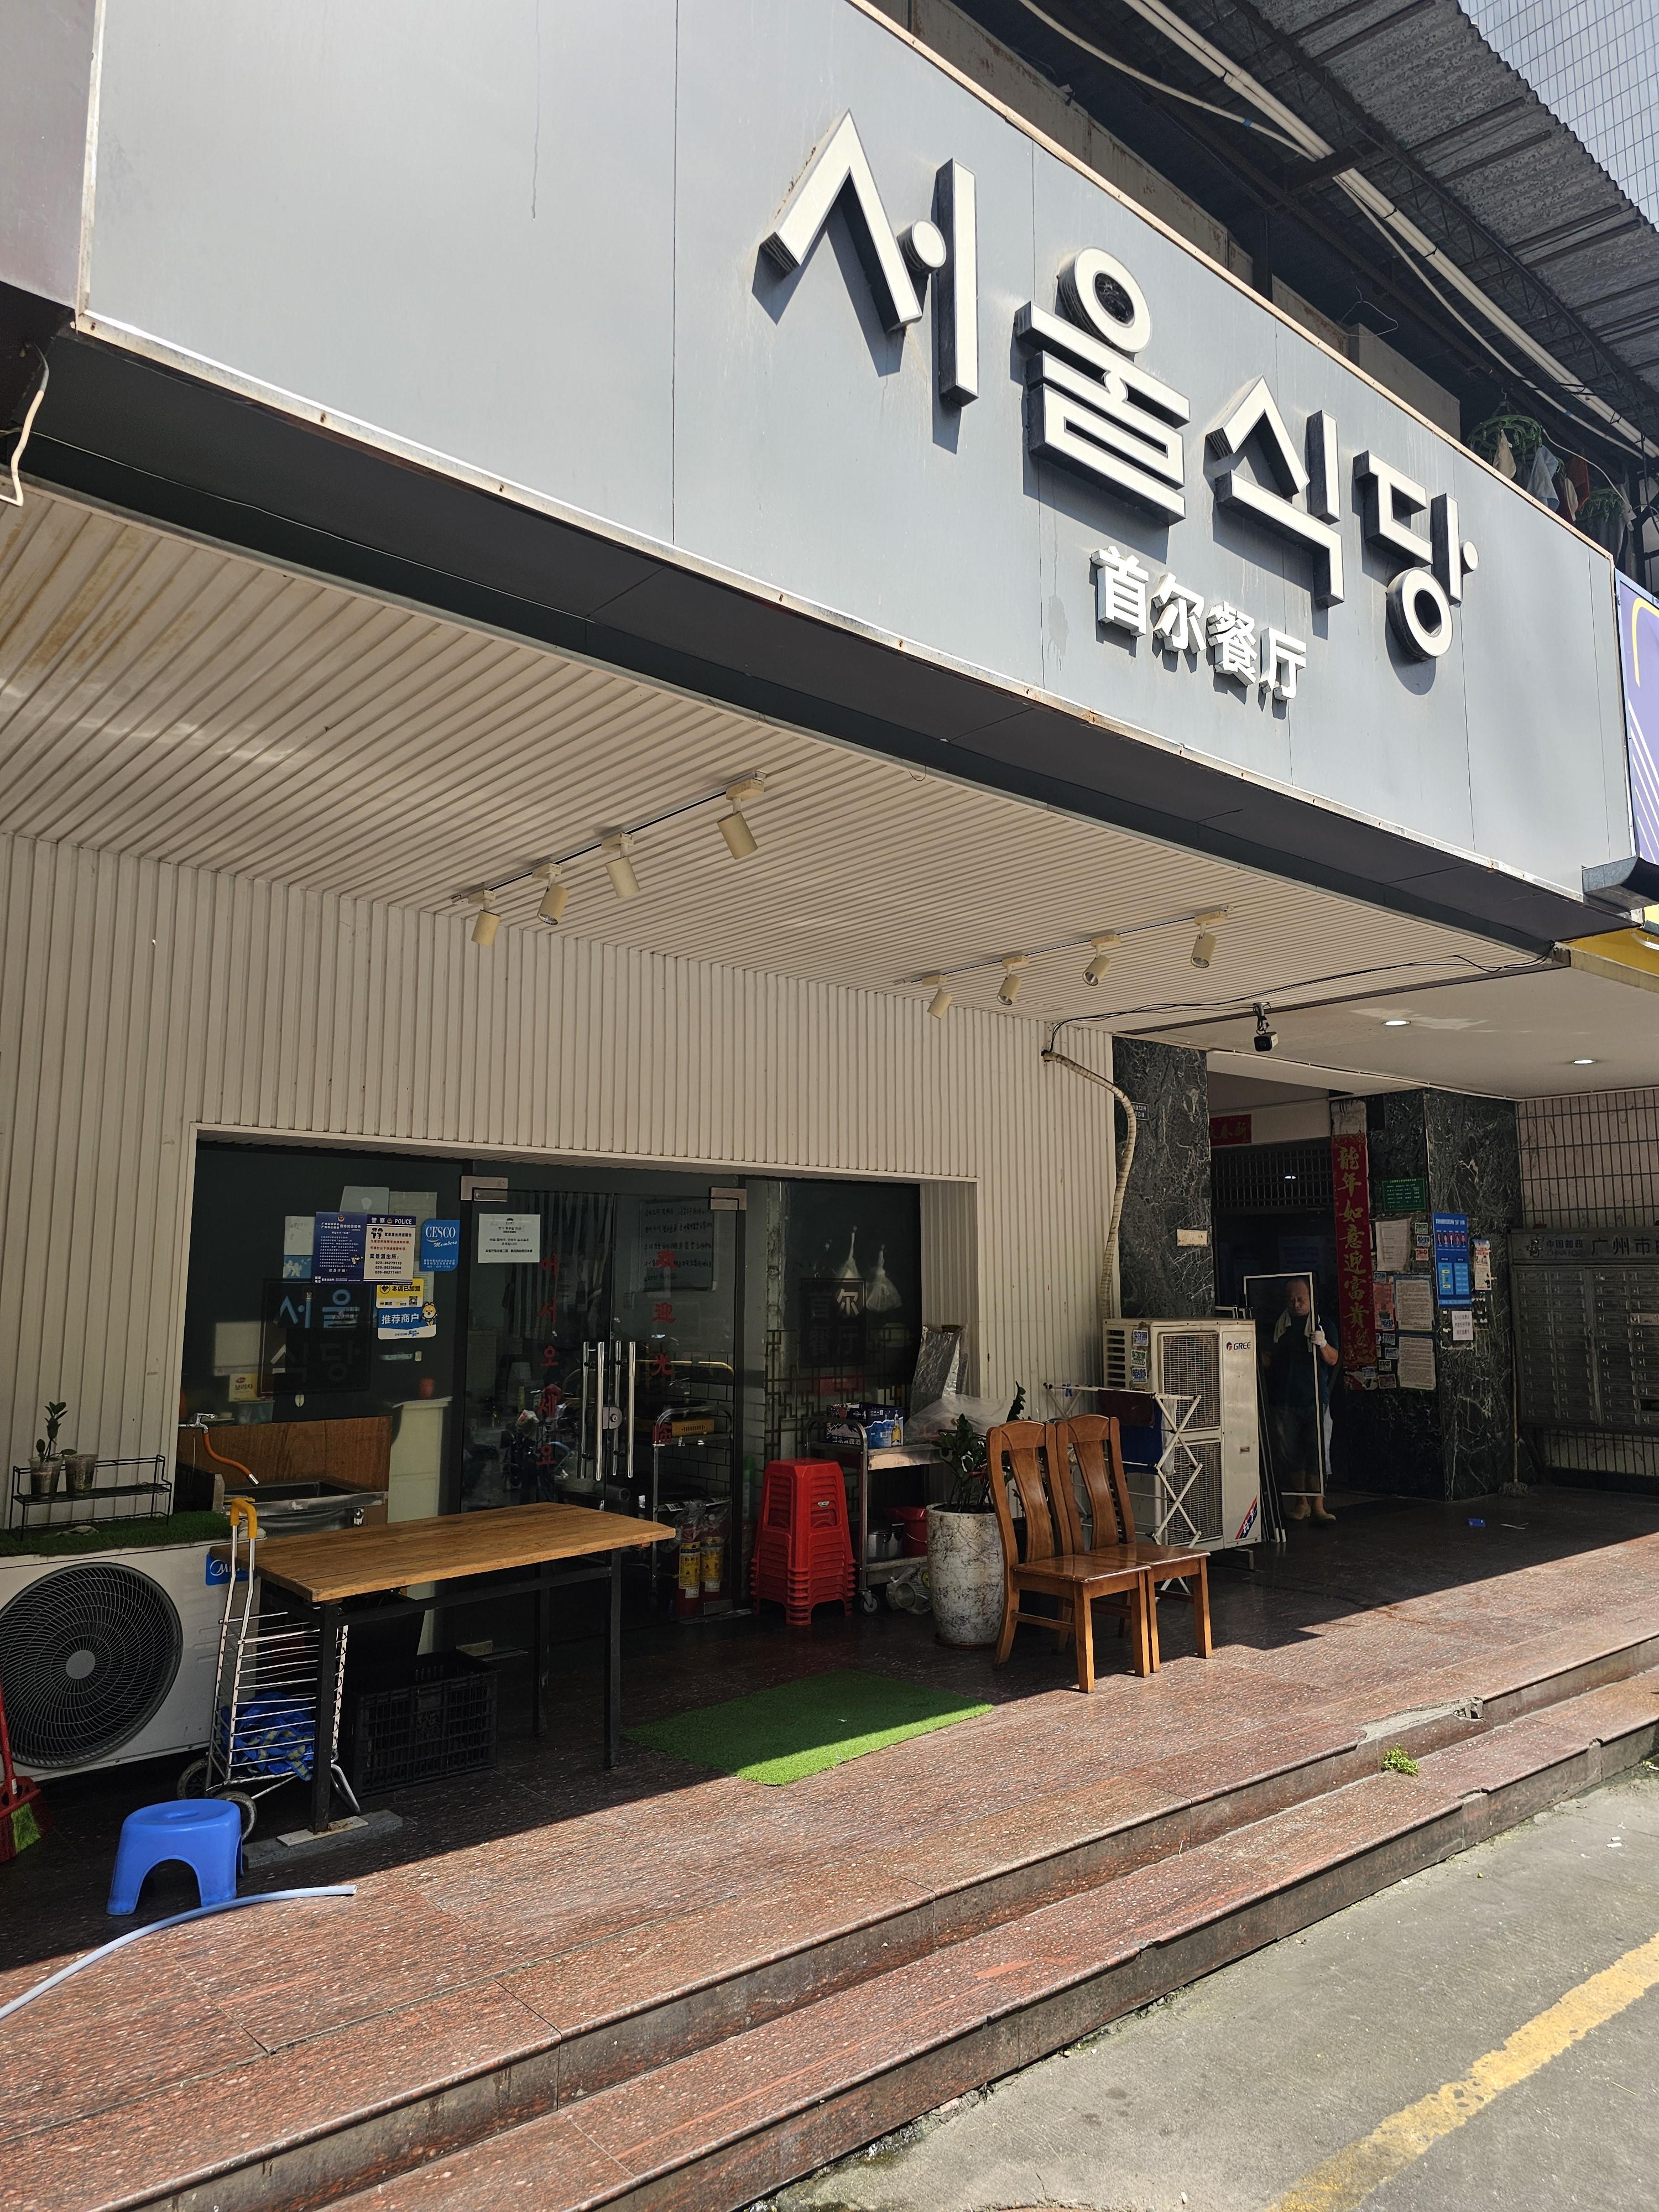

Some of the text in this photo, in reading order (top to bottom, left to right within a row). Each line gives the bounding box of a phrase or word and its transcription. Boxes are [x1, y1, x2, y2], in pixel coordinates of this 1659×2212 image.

[759, 108, 1479, 662] 서울식당
[1091, 547, 1310, 703] 首尔餐厅
[425, 1226, 456, 1238] CESCO
[1546, 1239, 1583, 1249] 中国邮政
[1592, 1237, 1659, 1255] 广州市
[273, 1289, 361, 1328] 서울
[382, 1313, 419, 1324] 推荐商户
[651, 1249, 678, 1444] 欢迎光临
[1233, 1341, 1251, 1350] GREE
[536, 1253, 559, 1467] 어서오세요
